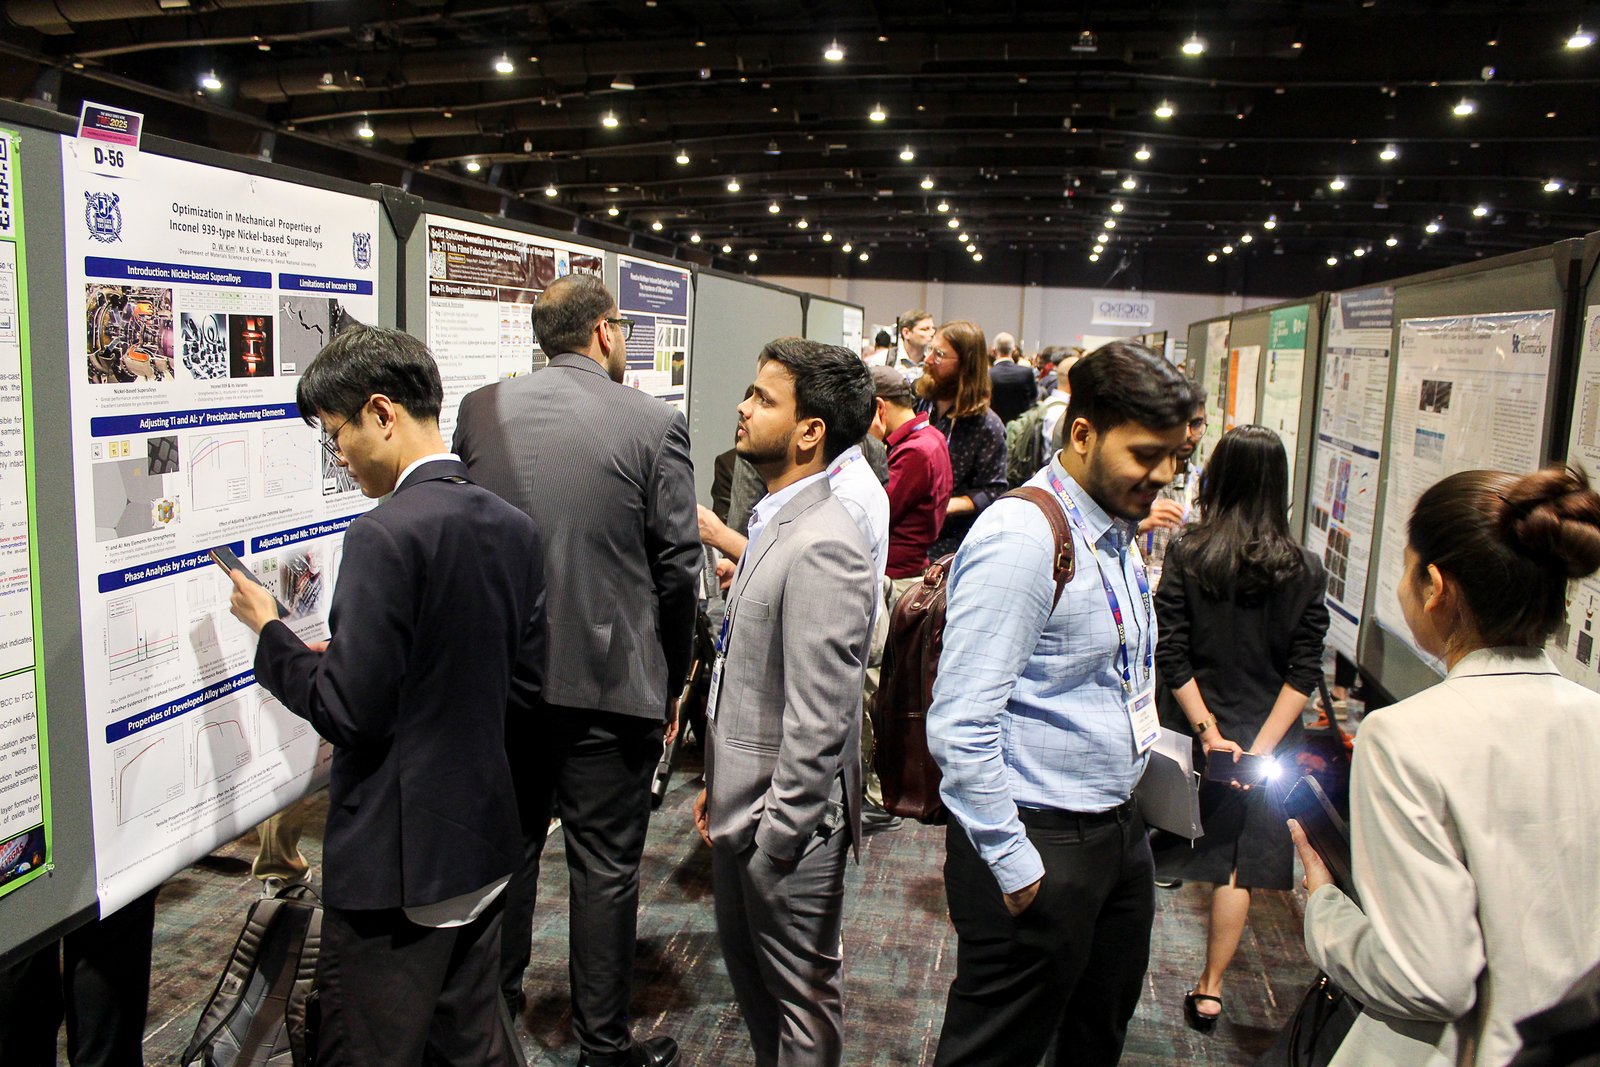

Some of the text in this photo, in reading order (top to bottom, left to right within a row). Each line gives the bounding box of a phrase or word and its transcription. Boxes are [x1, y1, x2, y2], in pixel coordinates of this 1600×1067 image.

[110, 119, 128, 128] 2025
[94, 147, 124, 168] D-56
[172, 203, 321, 234] Optimization in Mechanical Properties of
[170, 220, 322, 250] Inconel 939-type Nickel-based Superalloys
[431, 228, 444, 239] Solid
[128, 265, 241, 284] Introduction: Nickel-based Superalloys
[300, 278, 325, 289] Limitations
[326, 281, 331, 289] of
[332, 282, 348, 291] Inconel
[1100, 302, 1149, 314] OXFORD
[140, 418, 169, 429] Adjusting
[170, 416, 176, 426] Ti
[177, 415, 188, 426] and
[206, 410, 261, 422] Precipitate-forming
[262, 408, 285, 418] Elements
[259, 536, 283, 548] Adjusting
[283, 534, 289, 542] Ta
[290, 532, 299, 541] and
[309, 527, 318, 535] TCP
[319, 520, 350, 534] Phase-forming
[124, 567, 144, 582] Phase
[146, 561, 171, 578] Analysis
[172, 559, 180, 574] by
[181, 555, 196, 570] X-ray
[9, 636, 32, 648] indicates
[1, 698, 13, 708] BCC
[22, 691, 33, 701] FCC
[128, 674, 255, 731] Properties of Developed Alloy with 4-eleme
[111, 704, 127, 713] Another
[23, 712, 35, 721] HEA
[20, 734, 36, 743] shows
[12, 747, 26, 757] owing
[15, 764, 38, 777] becomes
[20, 773, 38, 786] sample
[1, 805, 13, 814] layer
[14, 796, 32, 810] formed
[4, 803, 40, 824] of oxide layer
